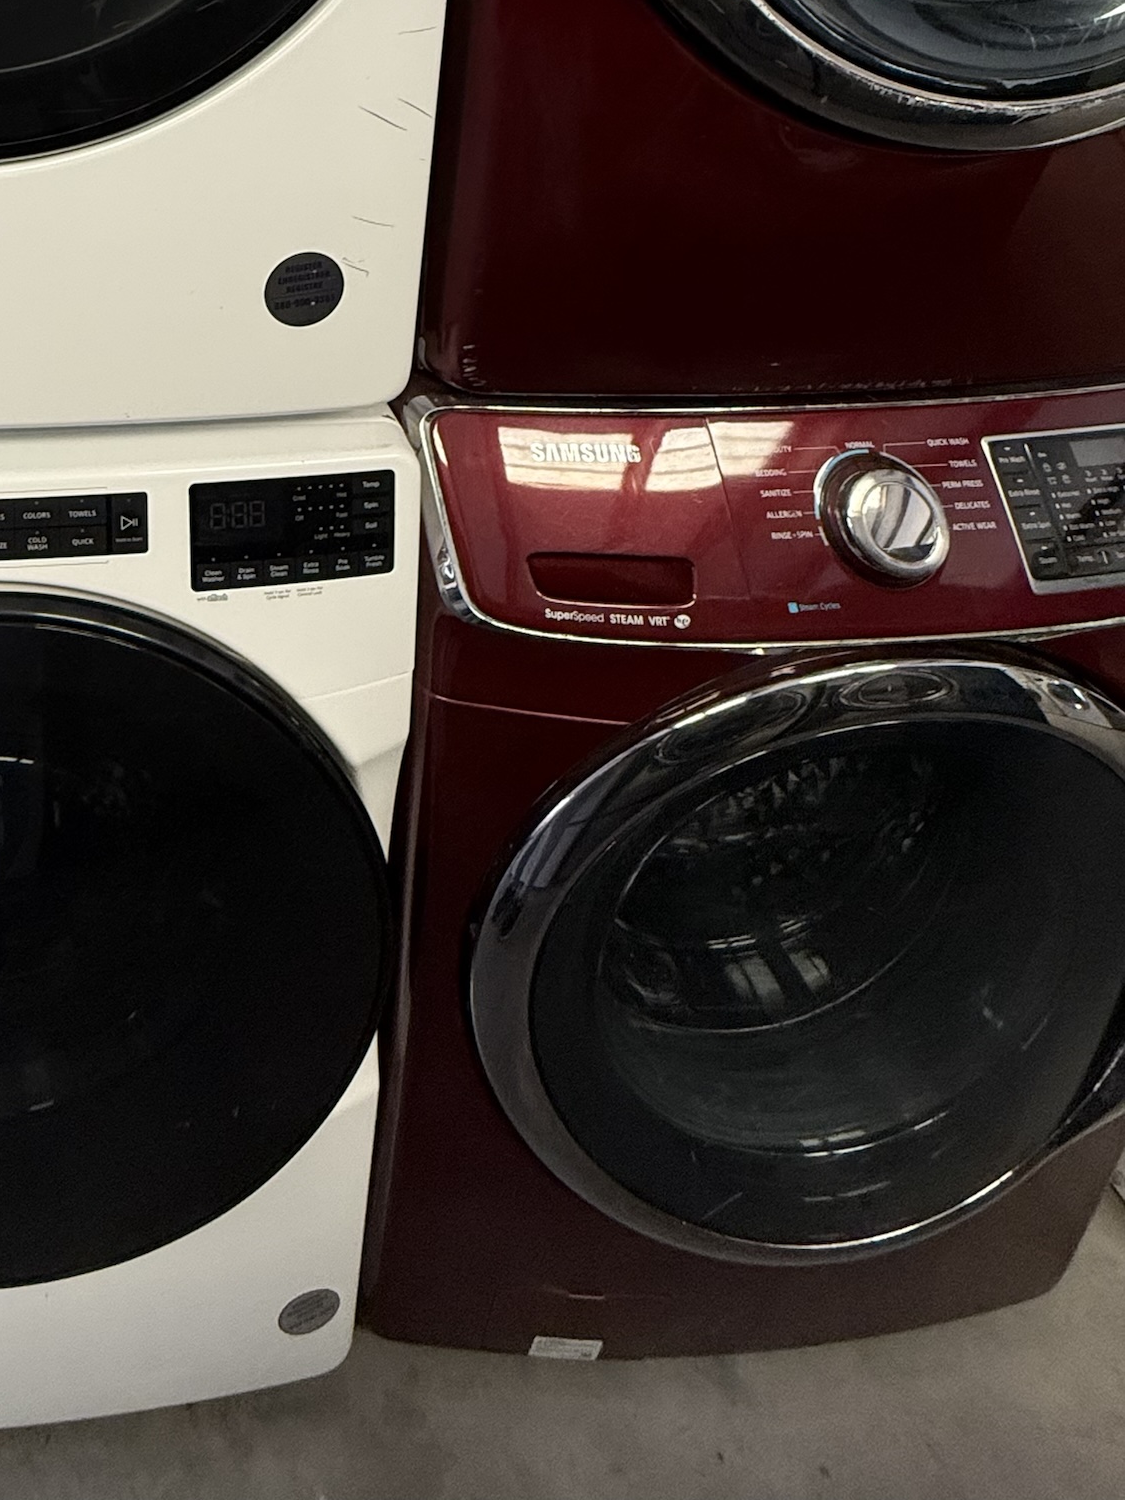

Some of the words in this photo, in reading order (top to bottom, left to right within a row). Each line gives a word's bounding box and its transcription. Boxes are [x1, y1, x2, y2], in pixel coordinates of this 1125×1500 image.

[927, 439, 946, 447] QUICK
[948, 437, 969, 445] WASH
[531, 442, 642, 464] SAMSUNG
[949, 460, 977, 468] TOWELS
[942, 481, 962, 489] PERM
[760, 490, 792, 498] SANITIZE
[954, 501, 991, 510] DELICATES
[69, 510, 96, 518] TOWELS
[767, 510, 803, 519] ALLERGEN
[953, 522, 976, 530] ACTIVE
[977, 521, 997, 529] WEAR
[545, 609, 604, 624] SuperSpeed
[610, 614, 644, 626] STEAM
